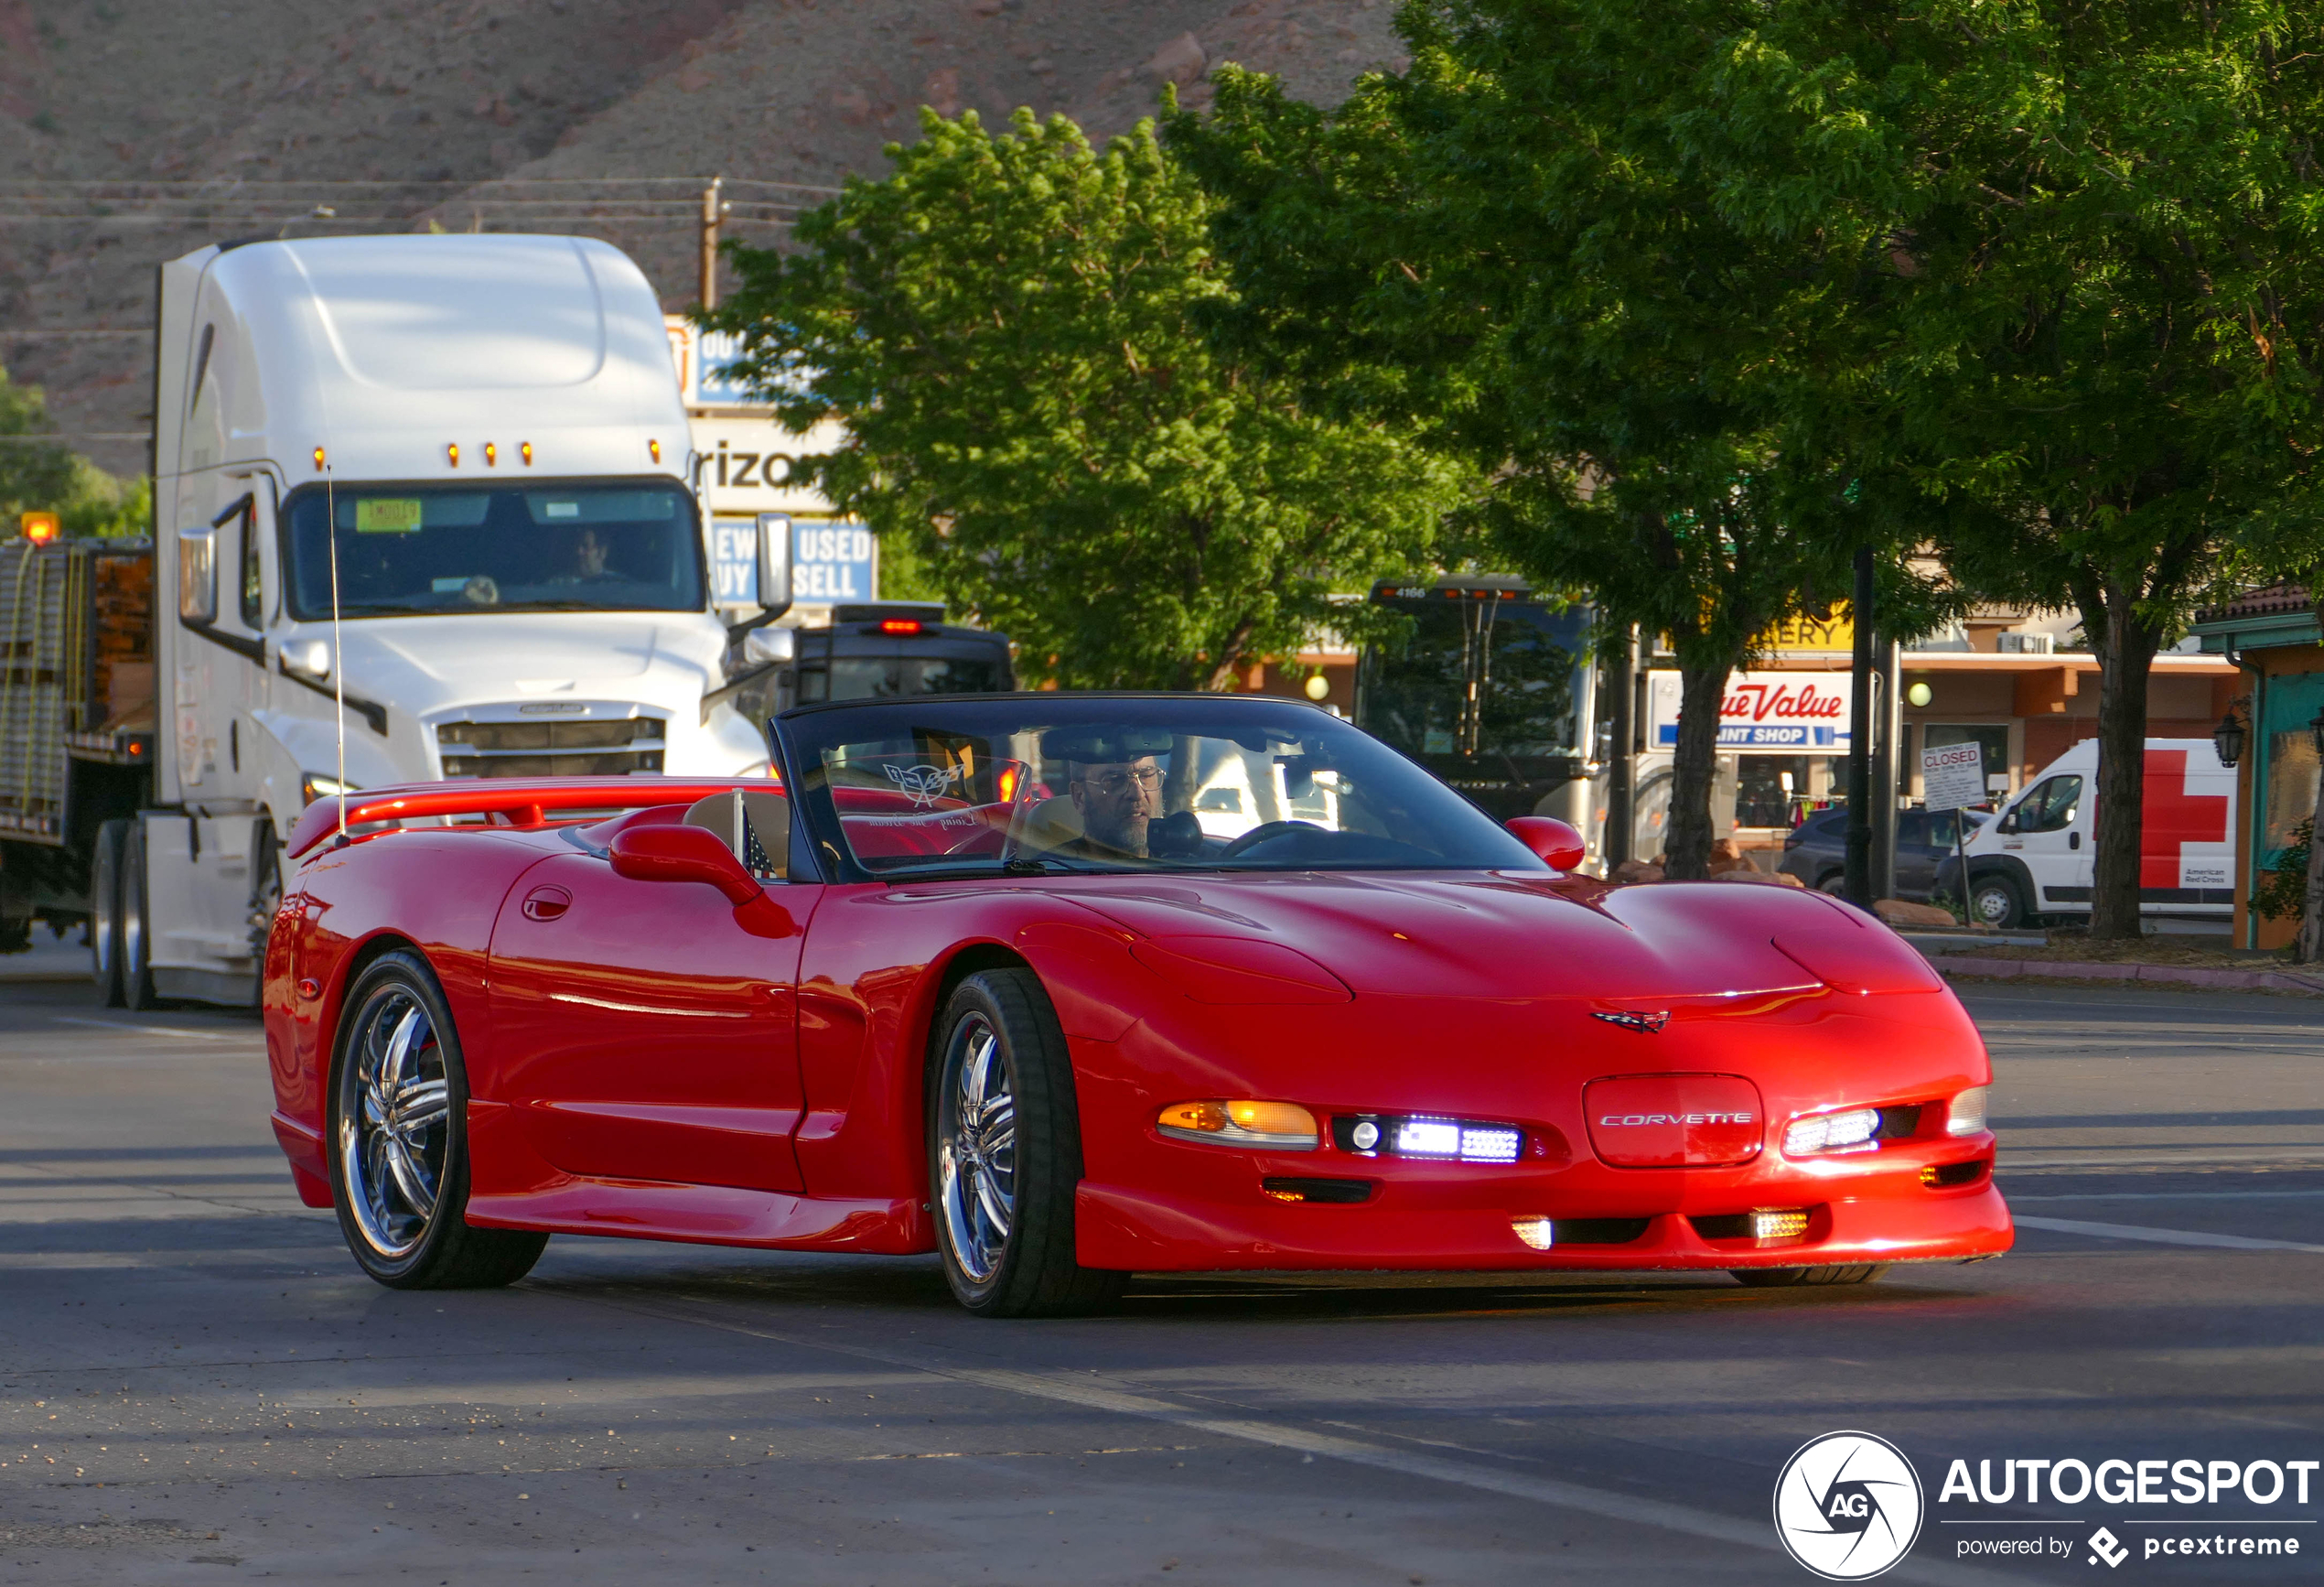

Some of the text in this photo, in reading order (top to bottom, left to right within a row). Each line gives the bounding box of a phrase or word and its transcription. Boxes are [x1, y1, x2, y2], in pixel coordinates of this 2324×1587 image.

[716, 526, 871, 563] EW USED
[717, 562, 857, 598] UY SELL
[1395, 587, 1426, 599] 4166
[1737, 684, 1842, 722] Value
[1717, 727, 1804, 743] INT SHOP
[1924, 750, 1977, 768] CLOSED
[1600, 1112, 1752, 1126] CORVETTE
